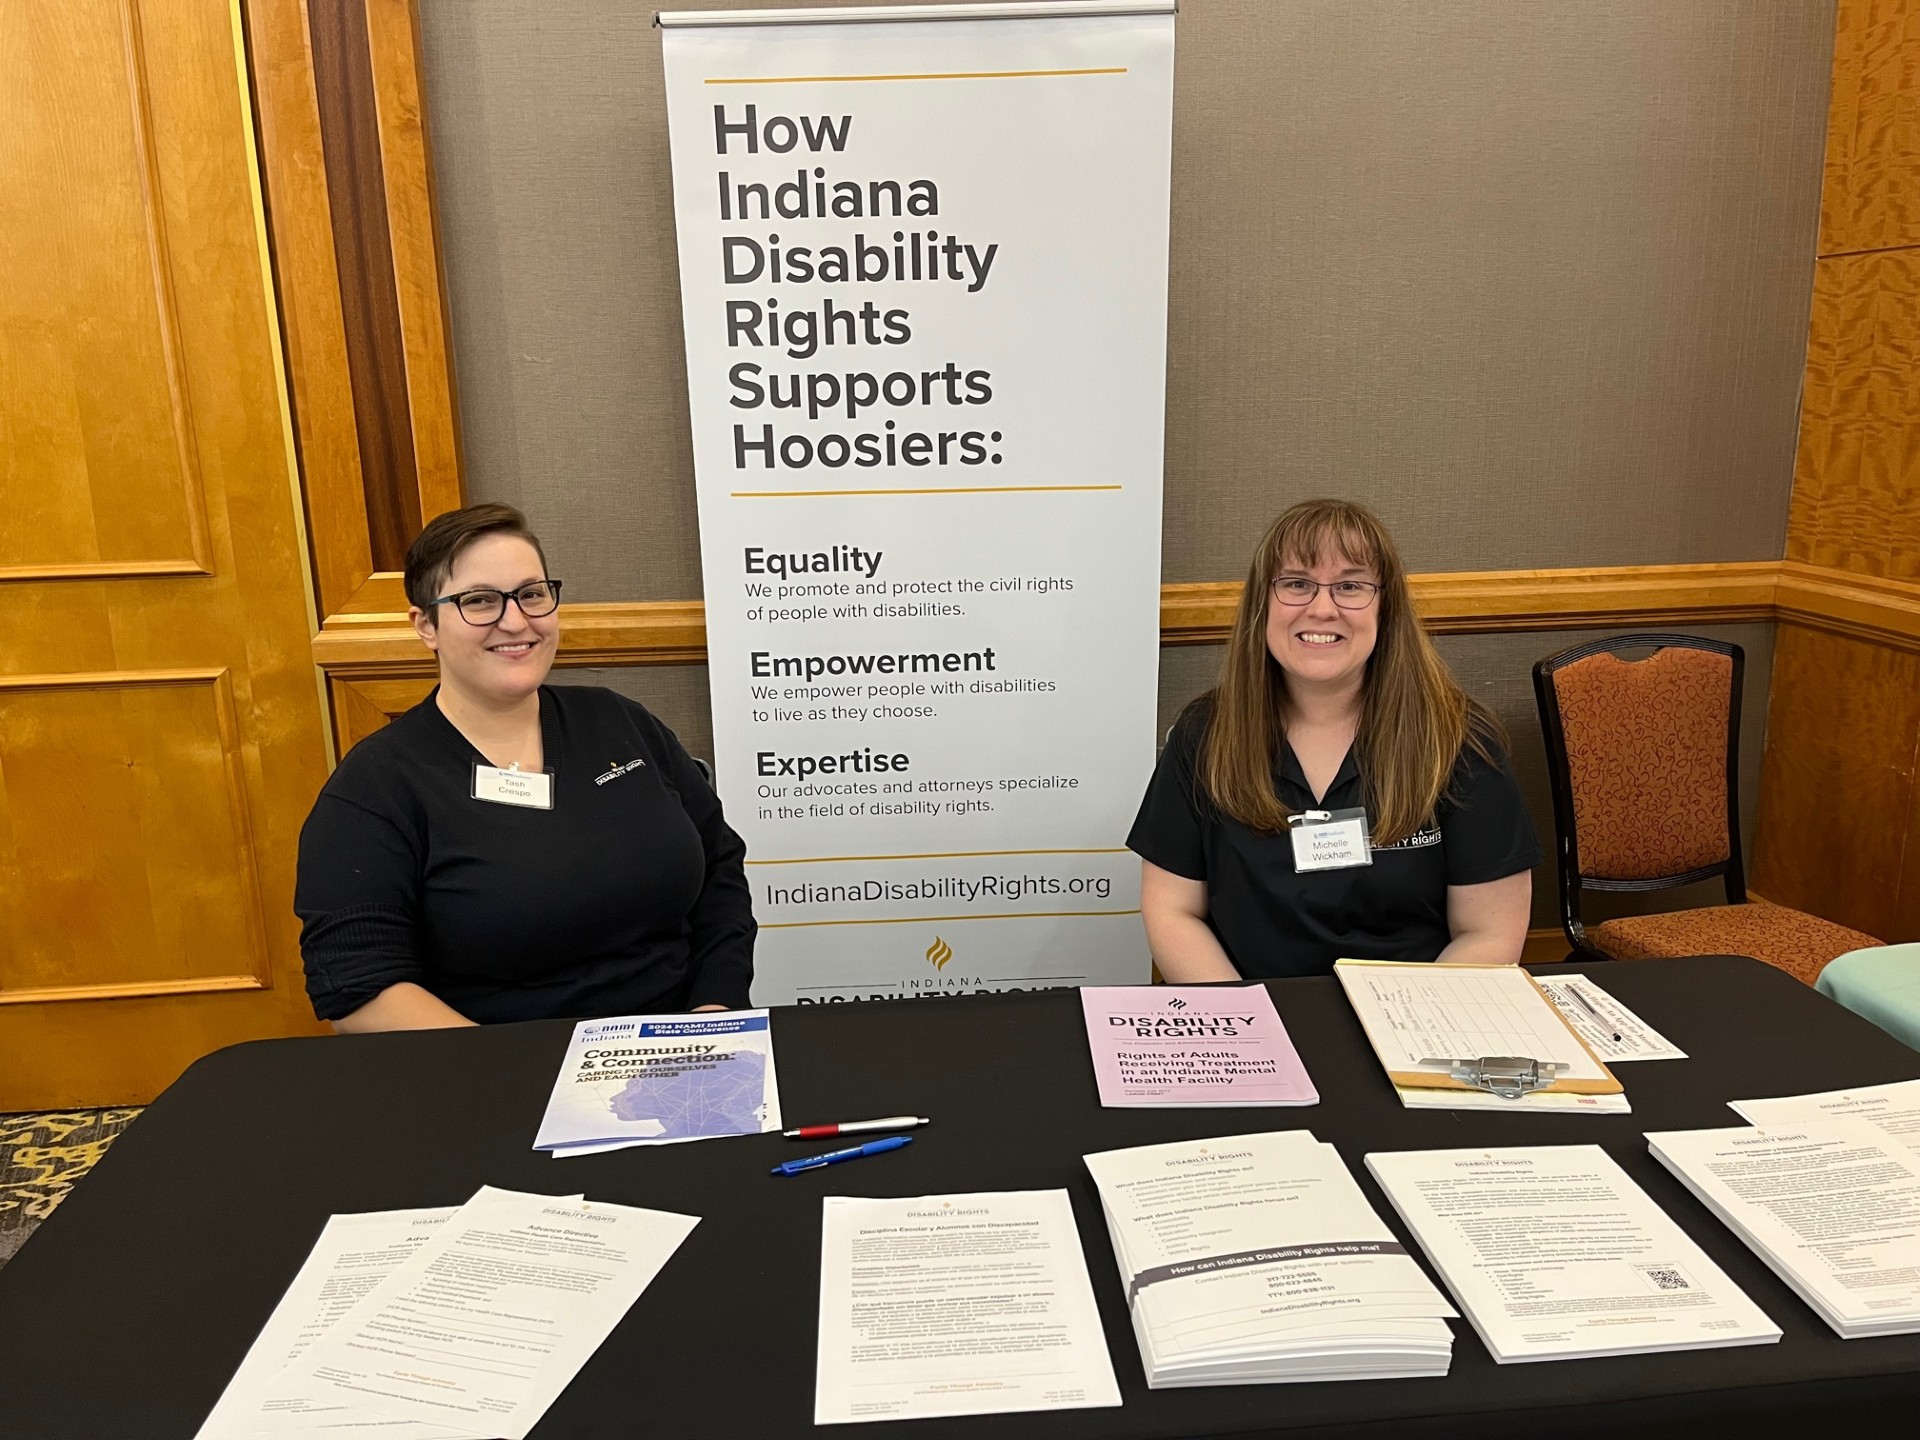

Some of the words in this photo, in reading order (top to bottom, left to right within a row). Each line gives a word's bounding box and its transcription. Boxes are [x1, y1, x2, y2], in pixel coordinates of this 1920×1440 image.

[714, 104, 852, 154] How
[719, 167, 938, 220] Indiana
[723, 231, 998, 292] Disability
[726, 298, 911, 358] Rights
[729, 363, 992, 419] Supports
[734, 421, 1003, 468] Hoosiers:
[745, 545, 883, 580] Equality
[745, 583, 772, 597] We
[779, 582, 850, 600] promote
[856, 581, 887, 594] and
[892, 579, 953, 597] protect
[957, 578, 984, 593] the
[989, 577, 1021, 591] civil
[1026, 576, 1074, 594] rights
[747, 606, 763, 621] of
[769, 605, 828, 623] people
[833, 603, 868, 617] with
[873, 601, 966, 618] disabilities.
[751, 647, 996, 681] Empowerment
[752, 686, 778, 700] We
[783, 684, 863, 702] empower
[868, 681, 926, 700] people
[930, 680, 965, 695] with
[969, 677, 1056, 693] disabilities
[752, 709, 769, 722] to
[774, 707, 803, 721] live
[808, 708, 827, 720] as
[831, 705, 868, 724] they
[872, 702, 938, 719] choose.
[757, 747, 910, 781] Expertise
[504, 779, 526, 788] Tash
[757, 784, 788, 798] Our
[793, 781, 878, 797] advocates
[883, 779, 913, 794] and
[918, 777, 993, 796] attorneys
[998, 774, 1079, 794] specialize
[499, 786, 531, 797] Crespo
[758, 806, 773, 819] in
[777, 804, 804, 819] the
[809, 802, 845, 818] field
[849, 802, 866, 816] of
[869, 799, 941, 820] disability
[945, 798, 994, 816] rights.
[1313, 840, 1348, 850] Michelle
[1411, 831, 1442, 846] RIGHTS
[1312, 851, 1352, 861] Wickham
[767, 873, 1111, 905] IndianaDisabilityRights.org
[900, 976, 982, 988] INDIANA
[706, 1020, 746, 1028] Indiana
[1109, 1016, 1256, 1027] DISABILITY
[683, 1025, 740, 1034] Conference
[1136, 1027, 1239, 1037] RIGHTS
[581, 1034, 632, 1043] Indiana
[584, 1044, 717, 1059] Community
[1117, 1052, 1167, 1061] Rights
[1171, 1051, 1187, 1059] of
[1190, 1051, 1239, 1059] Adults
[580, 1061, 595, 1070] &
[602, 1052, 735, 1068] Connection:
[1119, 1060, 1195, 1068] Receiving
[1198, 1059, 1277, 1067] Treatment
[577, 1069, 622, 1078] CARING
[648, 1064, 717, 1073] OURSELVES
[604, 1073, 637, 1081] EACH
[638, 1071, 679, 1079] OTHER
[1224, 1067, 1277, 1075] Mental
[1177, 1076, 1234, 1085] Facility
[1732, 1136, 1776, 1146] DISABILITY
[1165, 1157, 1216, 1166] DISABILITY
[1219, 1152, 1254, 1161] RIGHTS
[1454, 1159, 1500, 1167] DISABILITY
[1183, 1170, 1217, 1180] Disability
[1218, 1167, 1241, 1175] Rights
[906, 1209, 955, 1218] DISABILITY
[1174, 1207, 1203, 1216] Indiana
[1203, 1202, 1239, 1212] Disability
[1240, 1198, 1263, 1207] Rights
[412, 1216, 450, 1225] DISABIL
[542, 1208, 586, 1220] DISABILITY
[586, 1214, 617, 1224] RIGHTS
[527, 1224, 562, 1234] Advance
[563, 1229, 599, 1239] Directive
[859, 1227, 898, 1235] Disciplina
[987, 1220, 1039, 1229] Discapacidad
[1170, 1265, 1195, 1275] How
[1196, 1262, 1216, 1270] can
[1216, 1256, 1254, 1267] Indiana
[1256, 1249, 1302, 1262] Disability
[1303, 1246, 1336, 1256] Rights
[1336, 1244, 1359, 1254] help
[1361, 1244, 1381, 1252] me?
[1267, 1291, 1284, 1299] TTY:
[1260, 1298, 1361, 1314] IndianaDisabilityRights.org
